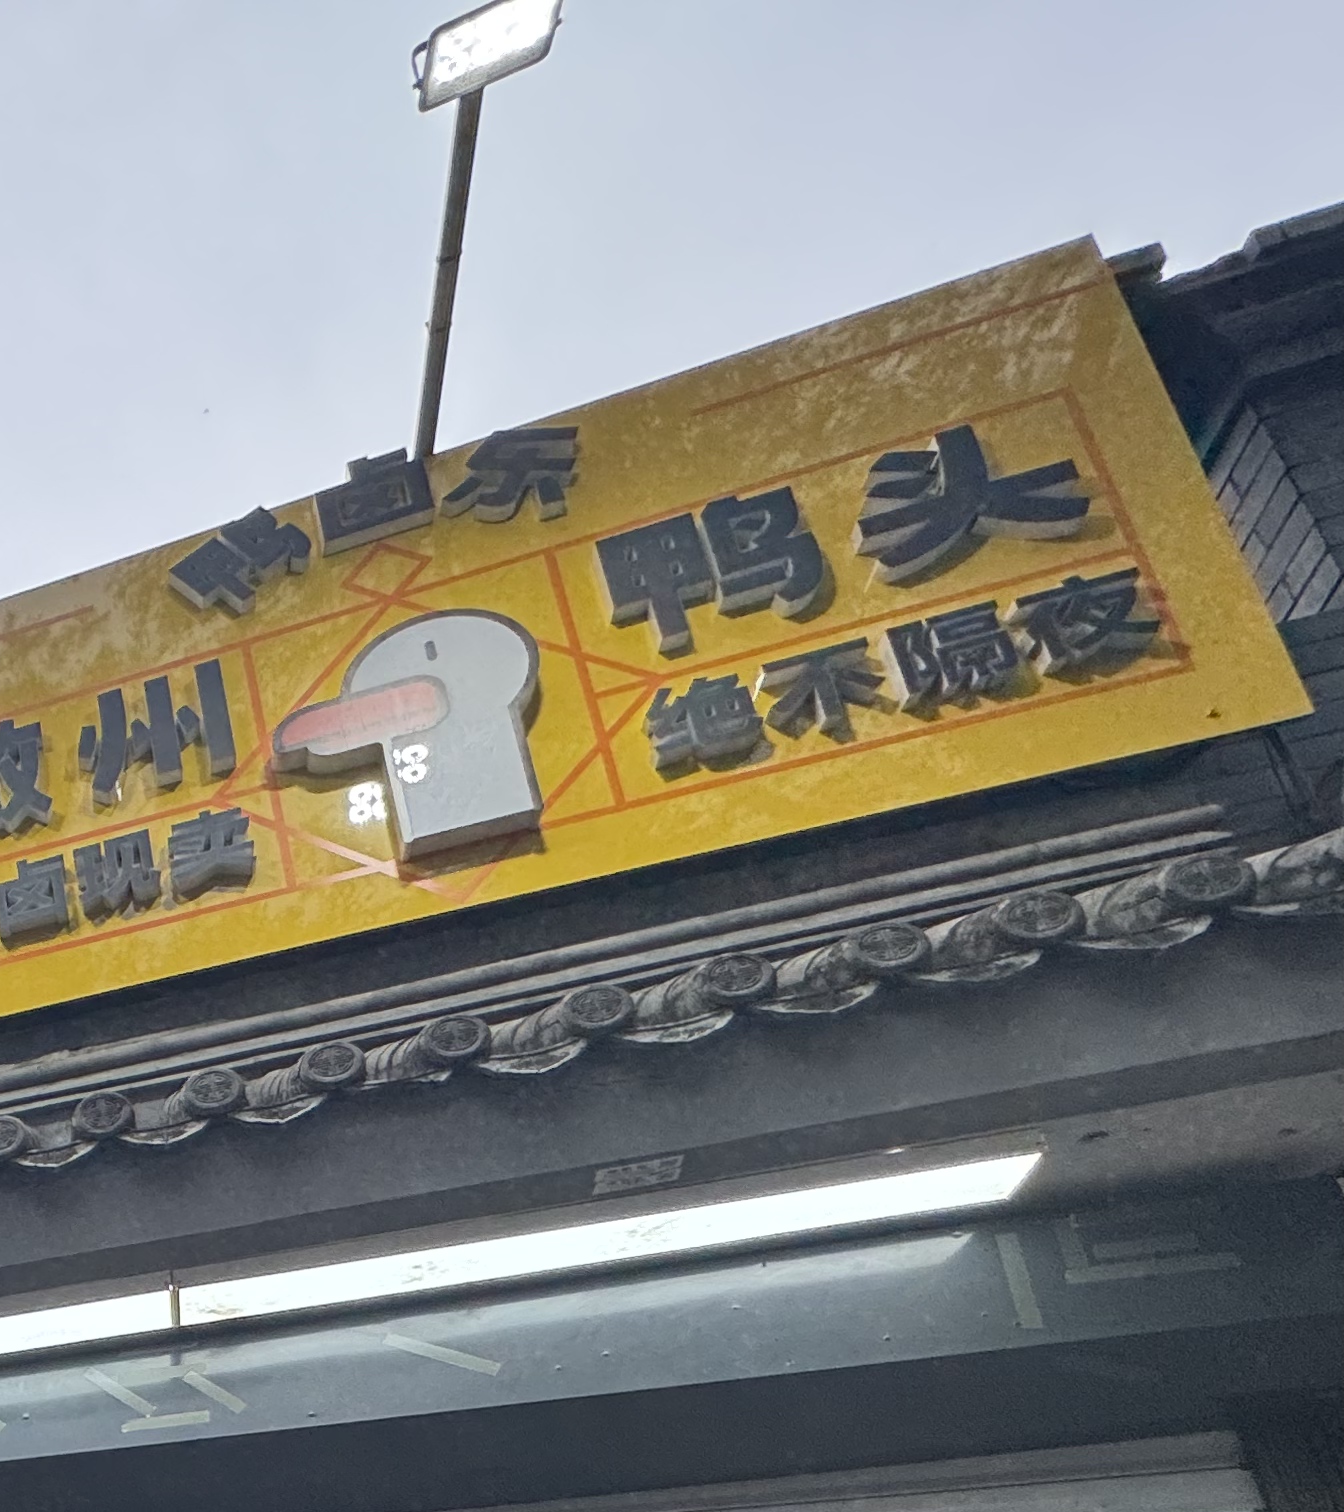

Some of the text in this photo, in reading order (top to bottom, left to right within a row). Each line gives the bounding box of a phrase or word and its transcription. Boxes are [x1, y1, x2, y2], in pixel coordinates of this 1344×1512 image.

[593, 424, 1090, 660] 鸭头
[643, 567, 1160, 782] 绝不隔夜
